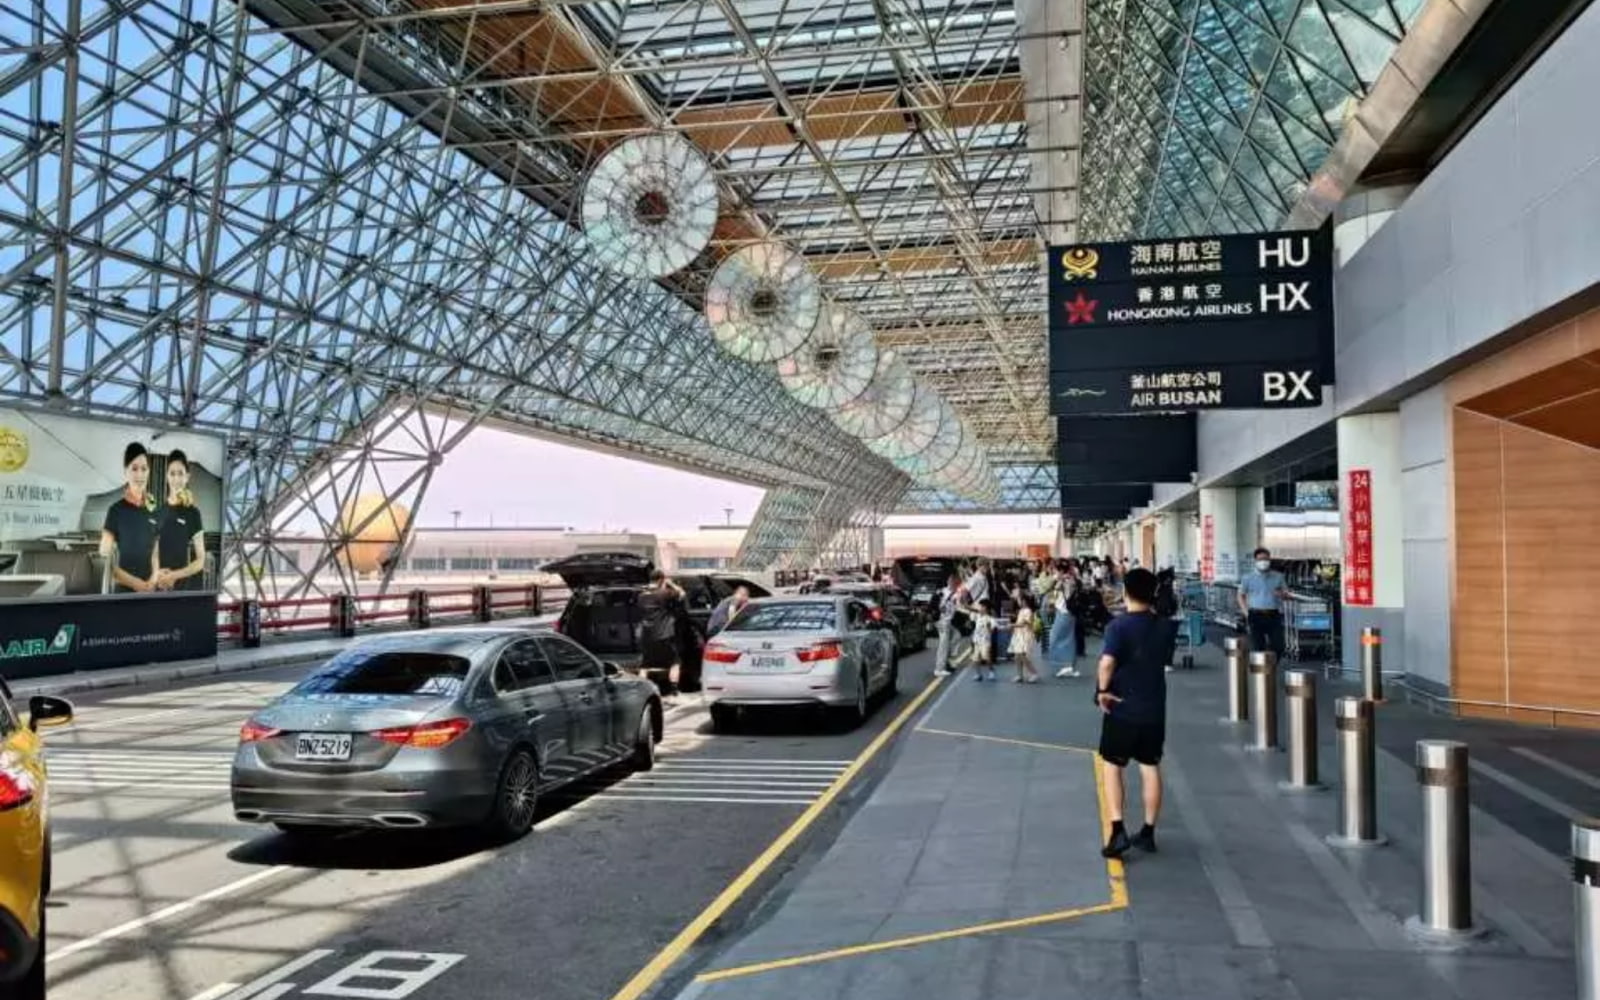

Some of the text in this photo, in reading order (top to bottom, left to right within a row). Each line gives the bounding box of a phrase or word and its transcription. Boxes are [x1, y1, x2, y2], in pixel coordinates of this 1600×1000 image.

[1131, 240, 1221, 264] 海南航空
[1258, 237, 1310, 268] HU
[1137, 283, 1222, 303] 香港航空
[1259, 281, 1311, 312] HX
[1107, 303, 1252, 321] HONGKONG AIRLINES
[1130, 371, 1221, 389] 釜山航空公司
[1263, 370, 1314, 401] BX
[1131, 390, 1221, 407] AIR BUSAN
